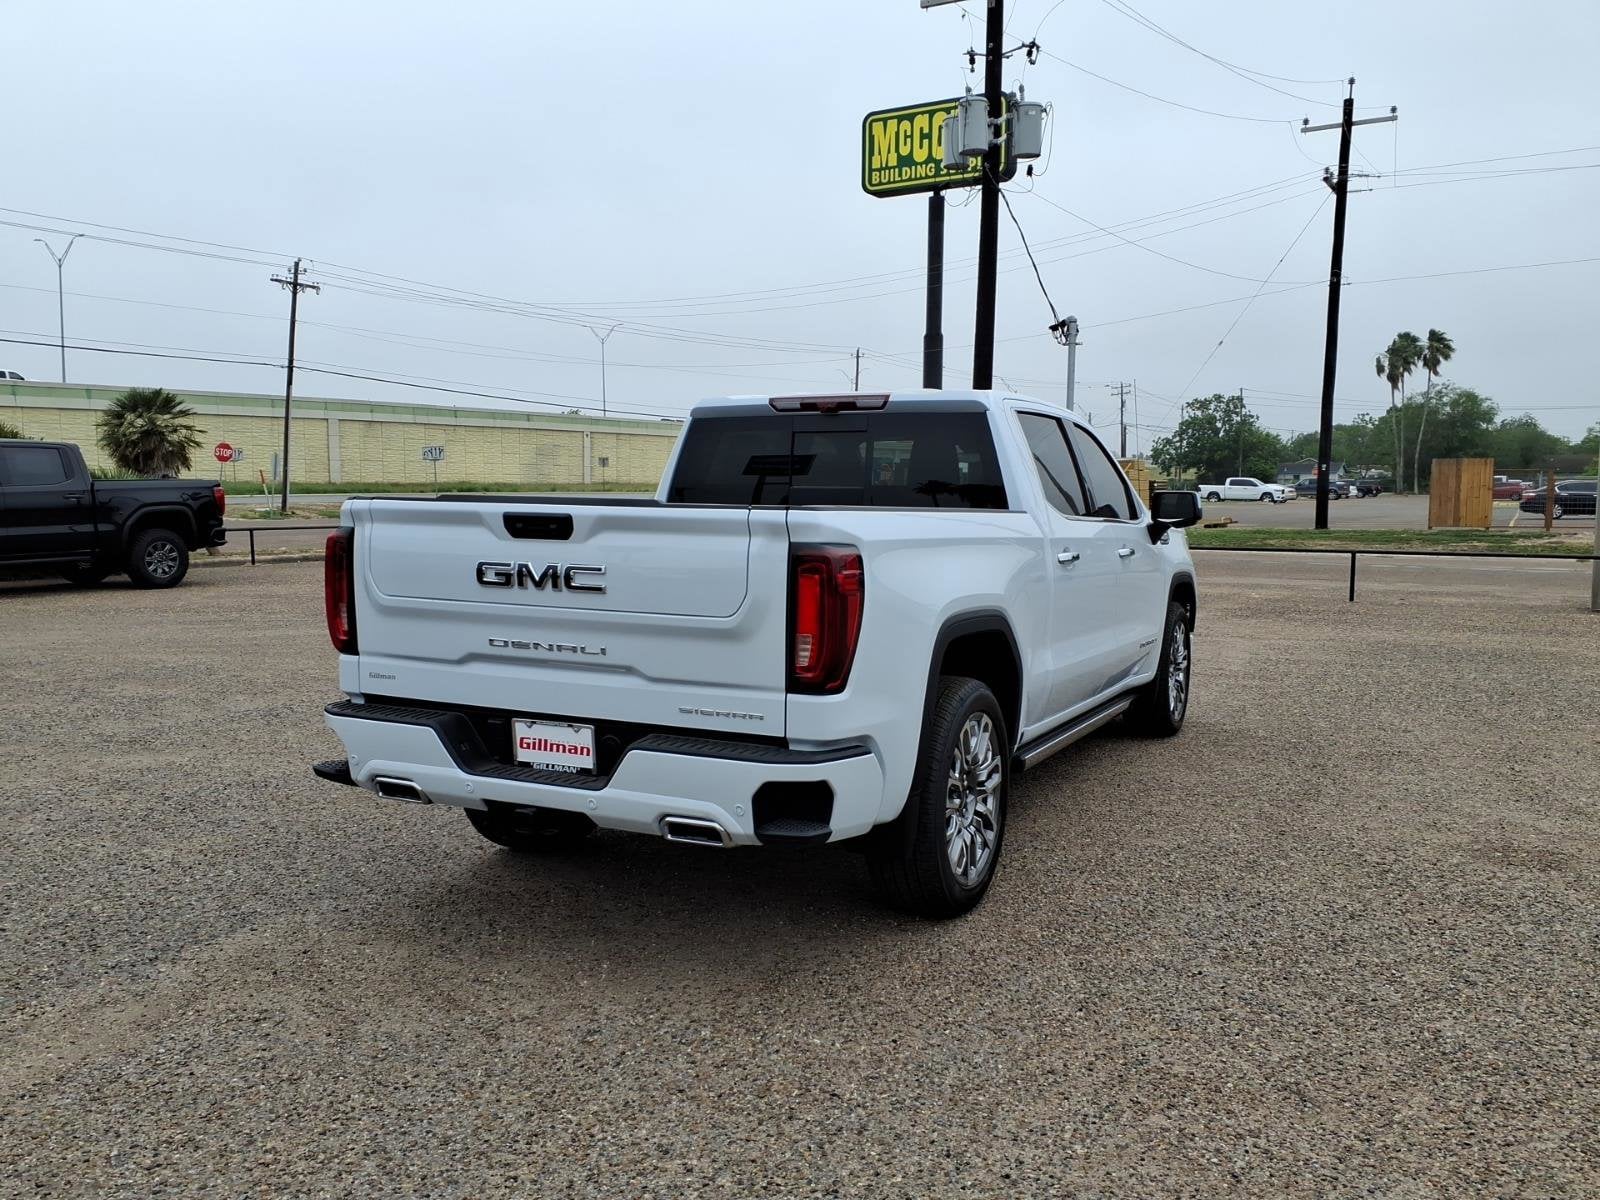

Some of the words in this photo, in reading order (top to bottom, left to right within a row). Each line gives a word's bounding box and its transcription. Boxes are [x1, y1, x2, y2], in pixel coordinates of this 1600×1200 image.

[872, 109, 960, 169] McCO
[872, 163, 935, 184] BUILDING
[215, 447, 233, 456] STOP
[476, 561, 606, 594] GMC
[489, 638, 607, 656] DENALI
[678, 707, 764, 720] SIERRA
[519, 736, 591, 757] Gillman
